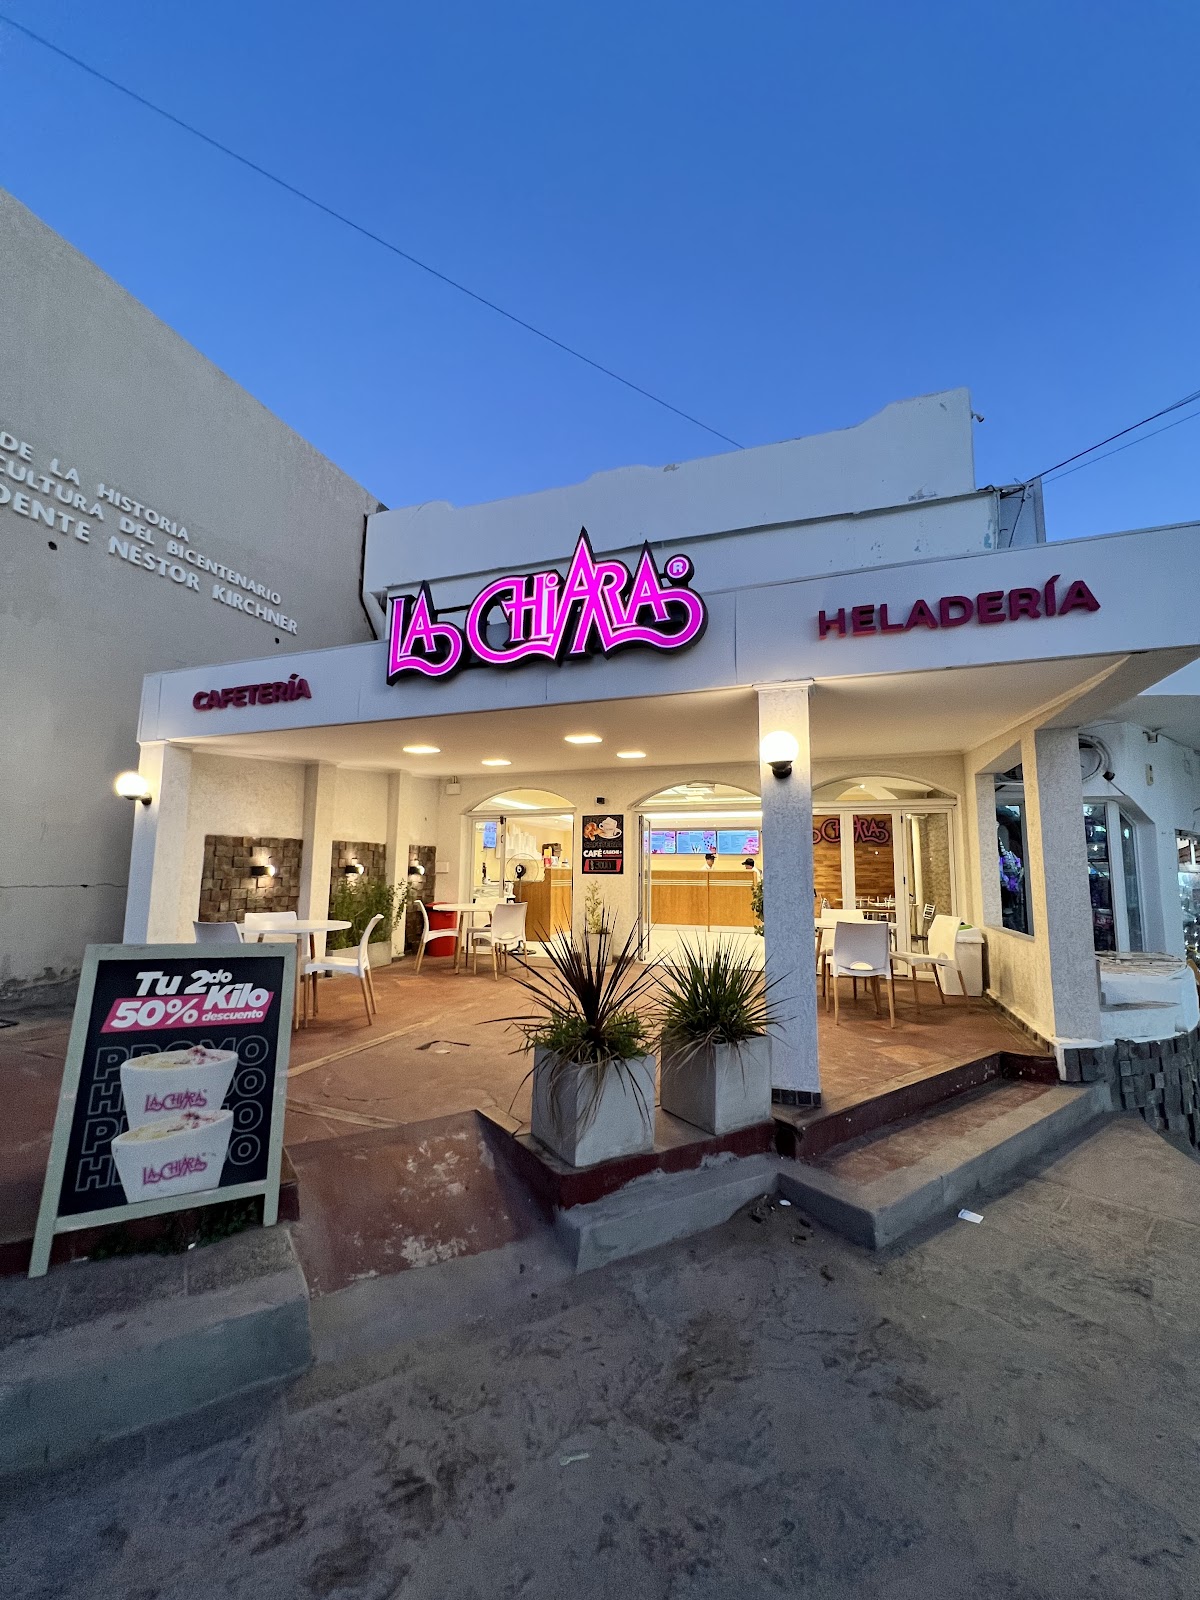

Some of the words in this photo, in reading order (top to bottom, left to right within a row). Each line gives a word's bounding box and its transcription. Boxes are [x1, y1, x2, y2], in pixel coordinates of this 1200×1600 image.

[0, 431, 34, 462] DE
[50, 458, 80, 486] LA
[97, 483, 189, 543] HISTORIA
[0, 455, 104, 521] ULTURA
[119, 516, 155, 545] DEL
[167, 540, 282, 605] BICENTENARIO
[212, 584, 298, 635] KIRCHNER
[388, 584, 463, 681] LA
[818, 574, 1101, 640] HELADERÍA
[193, 673, 312, 710] CAFETERÍA
[583, 849, 602, 857] CAFÉ
[111, 999, 200, 1029] 50%
[202, 1010, 264, 1022] descuento
[136, 971, 182, 997] Tu
[202, 983, 270, 1010] Kilo
